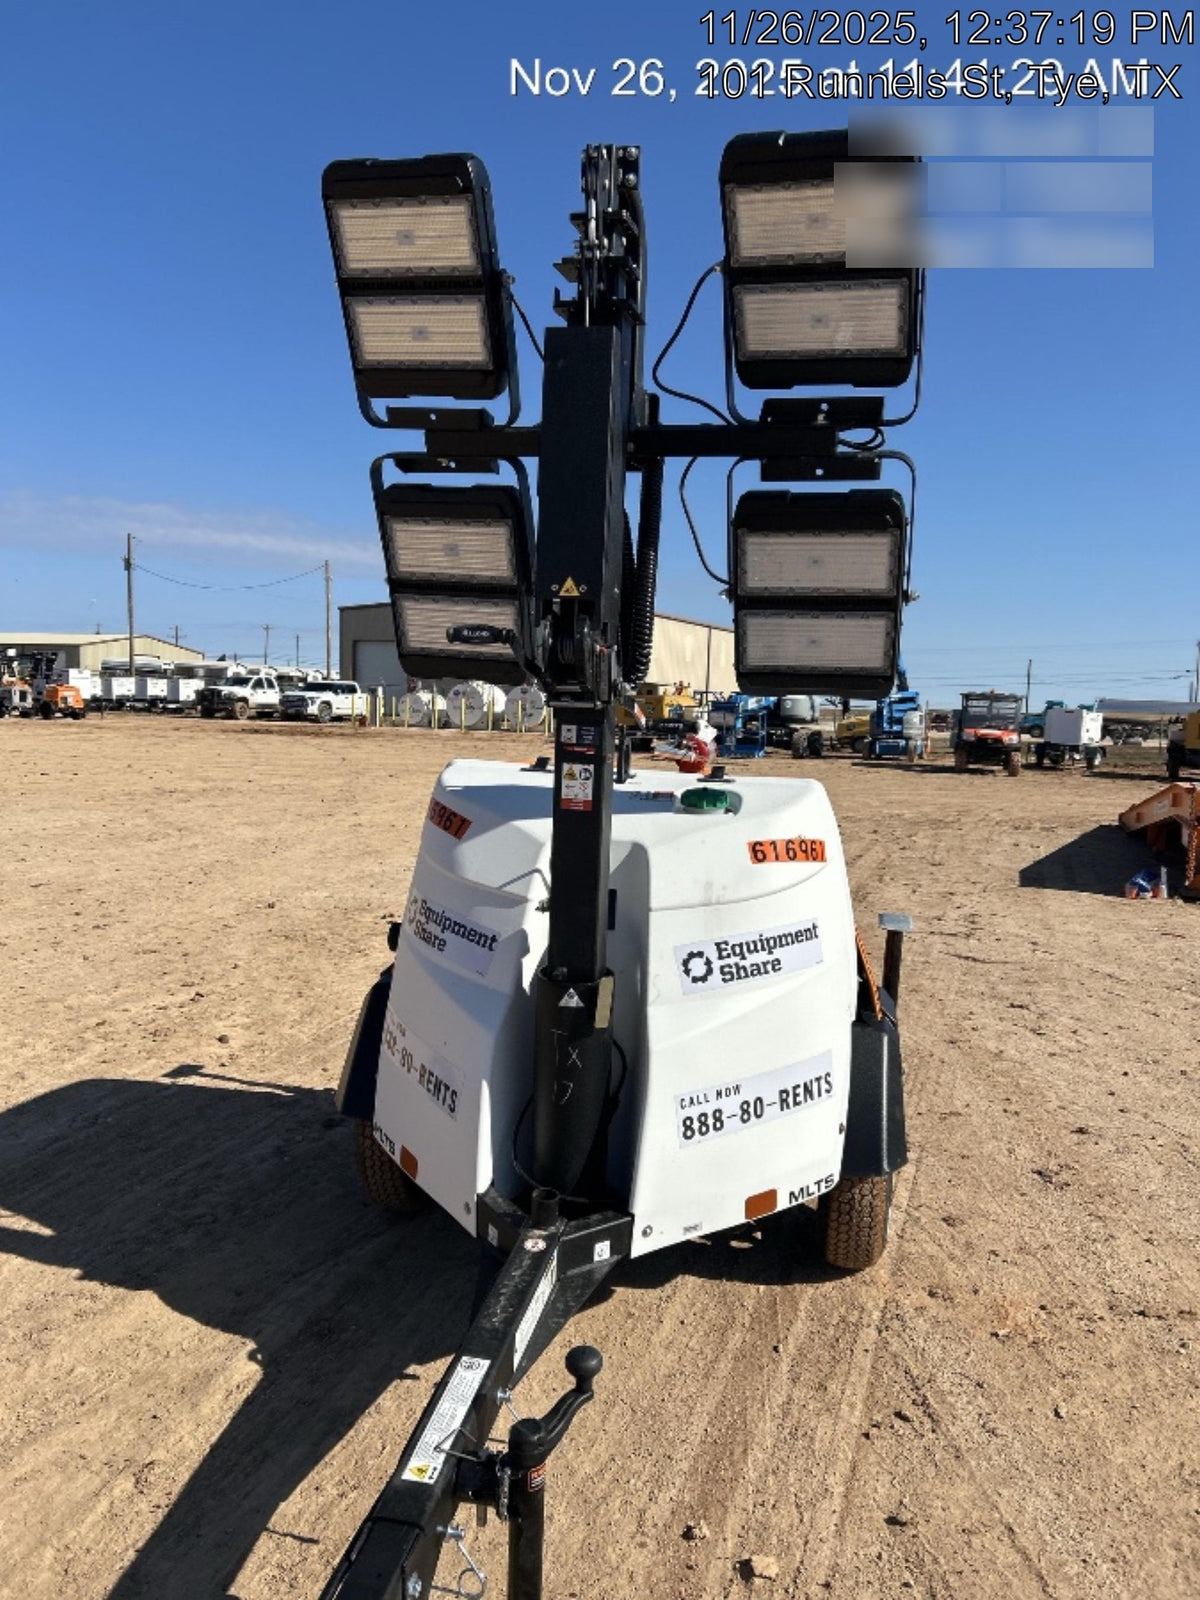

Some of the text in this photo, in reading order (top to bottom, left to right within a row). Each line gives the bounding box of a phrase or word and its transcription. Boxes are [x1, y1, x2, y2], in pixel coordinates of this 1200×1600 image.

[413, 919, 448, 952] Share
[419, 898, 499, 952] Equipment
[714, 921, 819, 961] Equipment
[719, 957, 783, 984] Share
[680, 1084, 742, 1110] CALL NOW
[682, 1071, 833, 1141] 888-80-RENTS
[788, 1173, 835, 1205] MLTS
